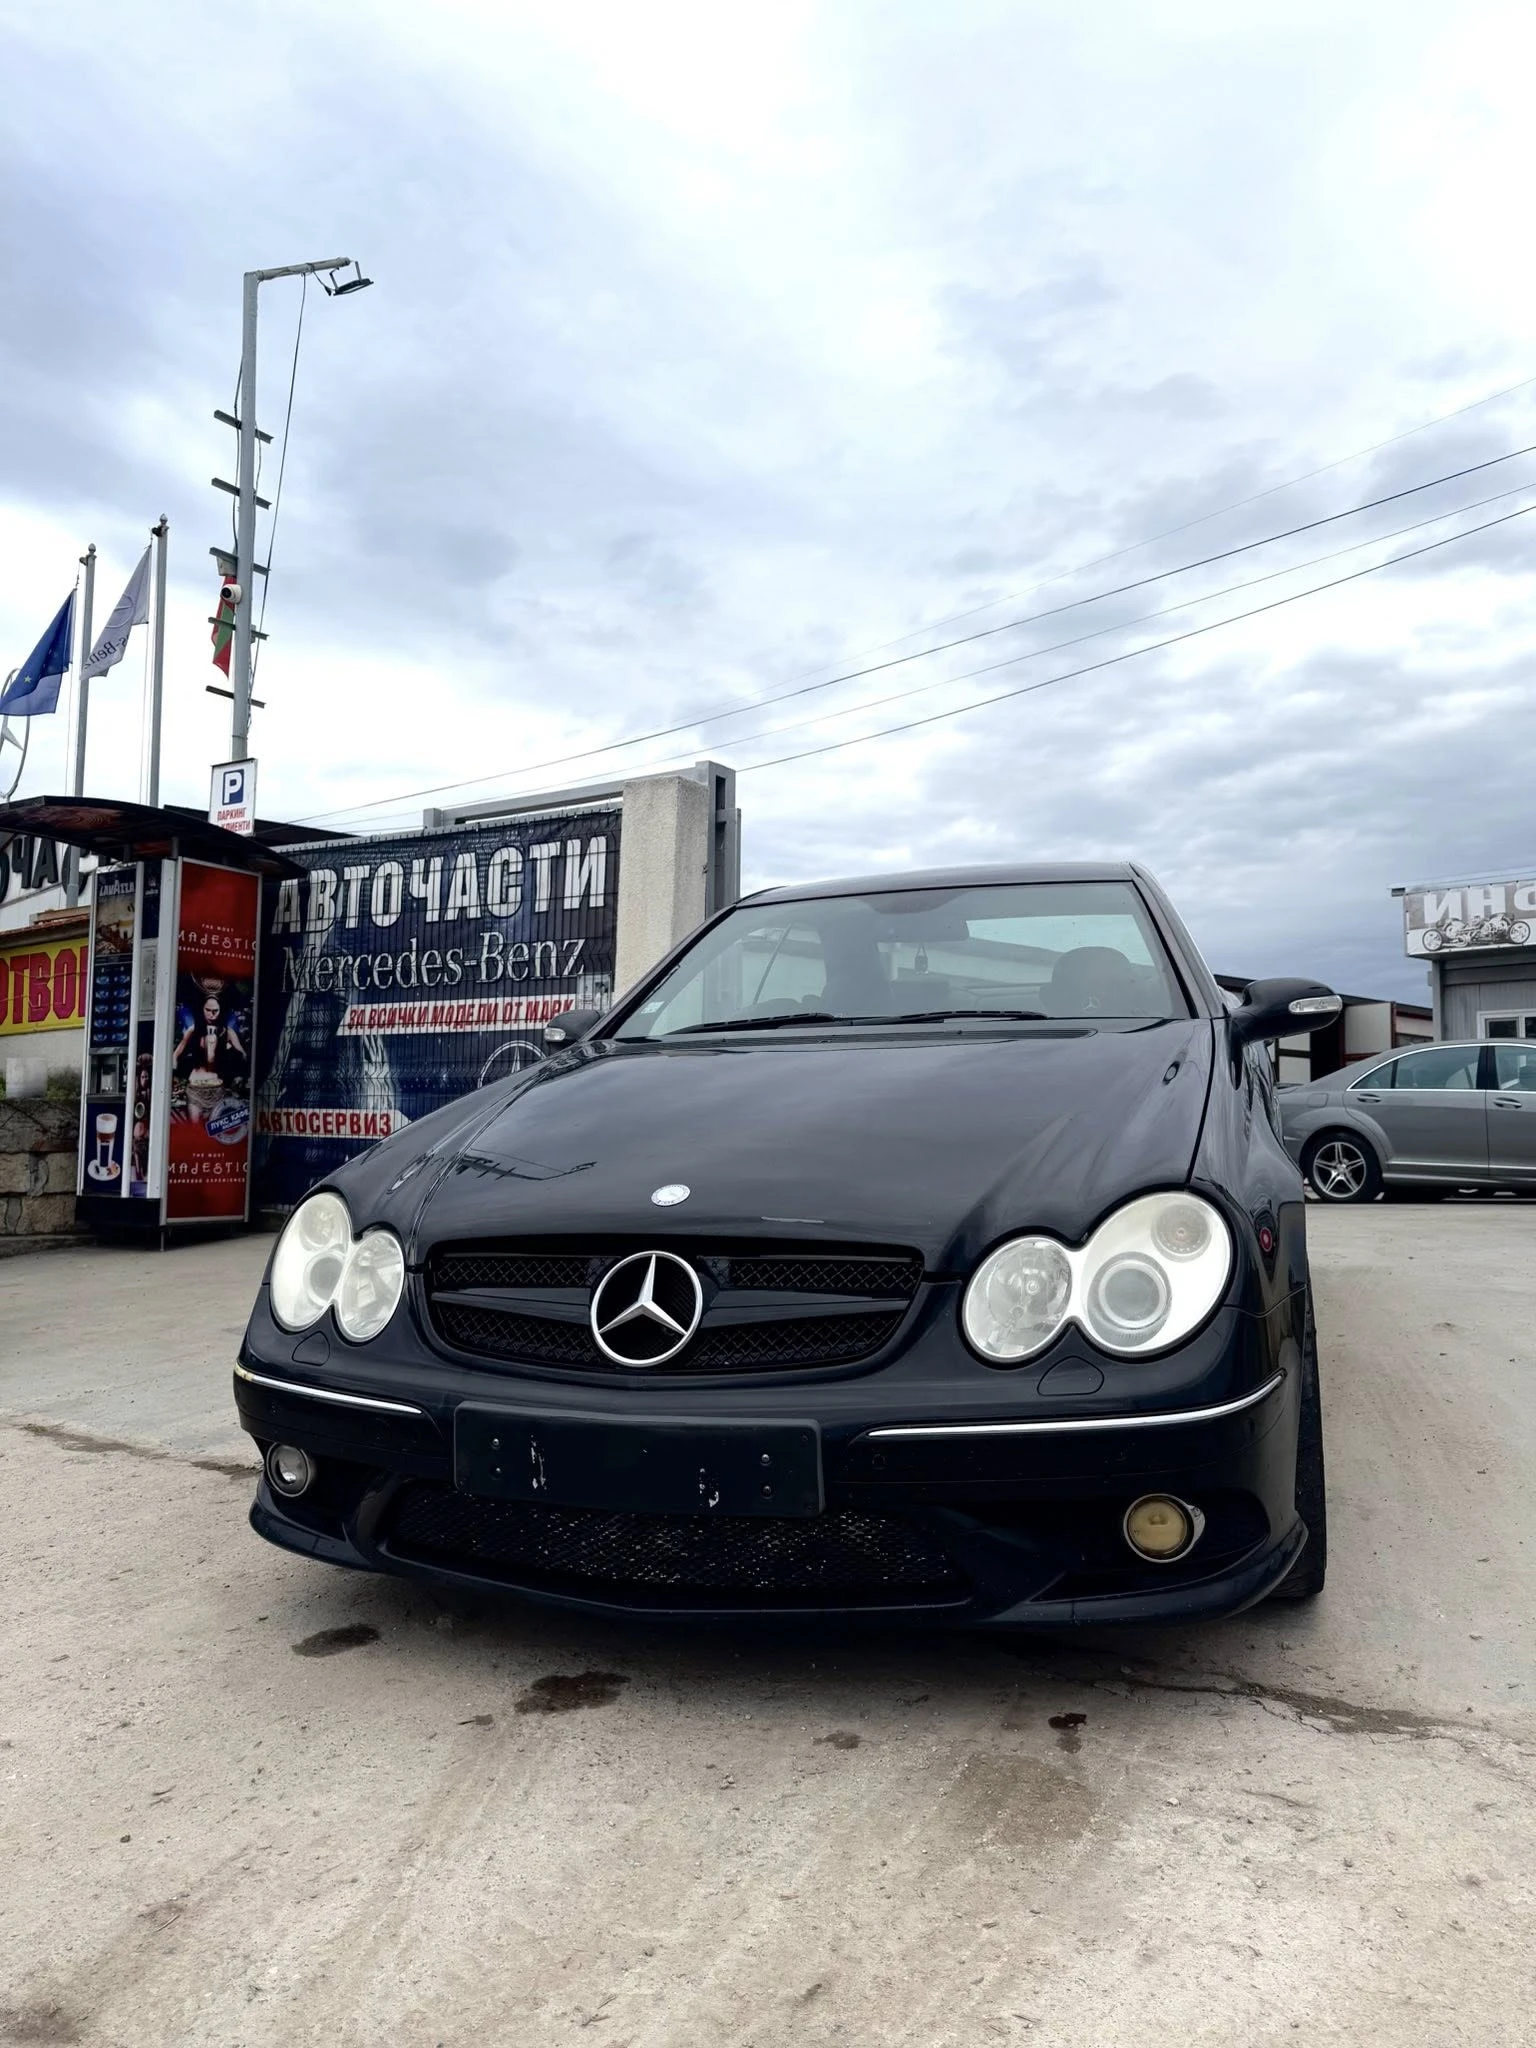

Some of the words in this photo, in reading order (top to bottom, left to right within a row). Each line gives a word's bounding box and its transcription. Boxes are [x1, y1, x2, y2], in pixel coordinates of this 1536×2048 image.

[217, 807, 247, 822] ПАРКИНГ
[270, 836, 608, 936] АВТОЧАСТИ
[281, 931, 585, 993] Mercedes-Benz
[347, 1007, 364, 1030] ЗА
[369, 1002, 427, 1029] ВСИЧКИ
[430, 999, 498, 1029] МОДЕЛИ
[502, 1002, 521, 1025] ОТ
[258, 1111, 391, 1136] АВТОСЕРВИЗ
